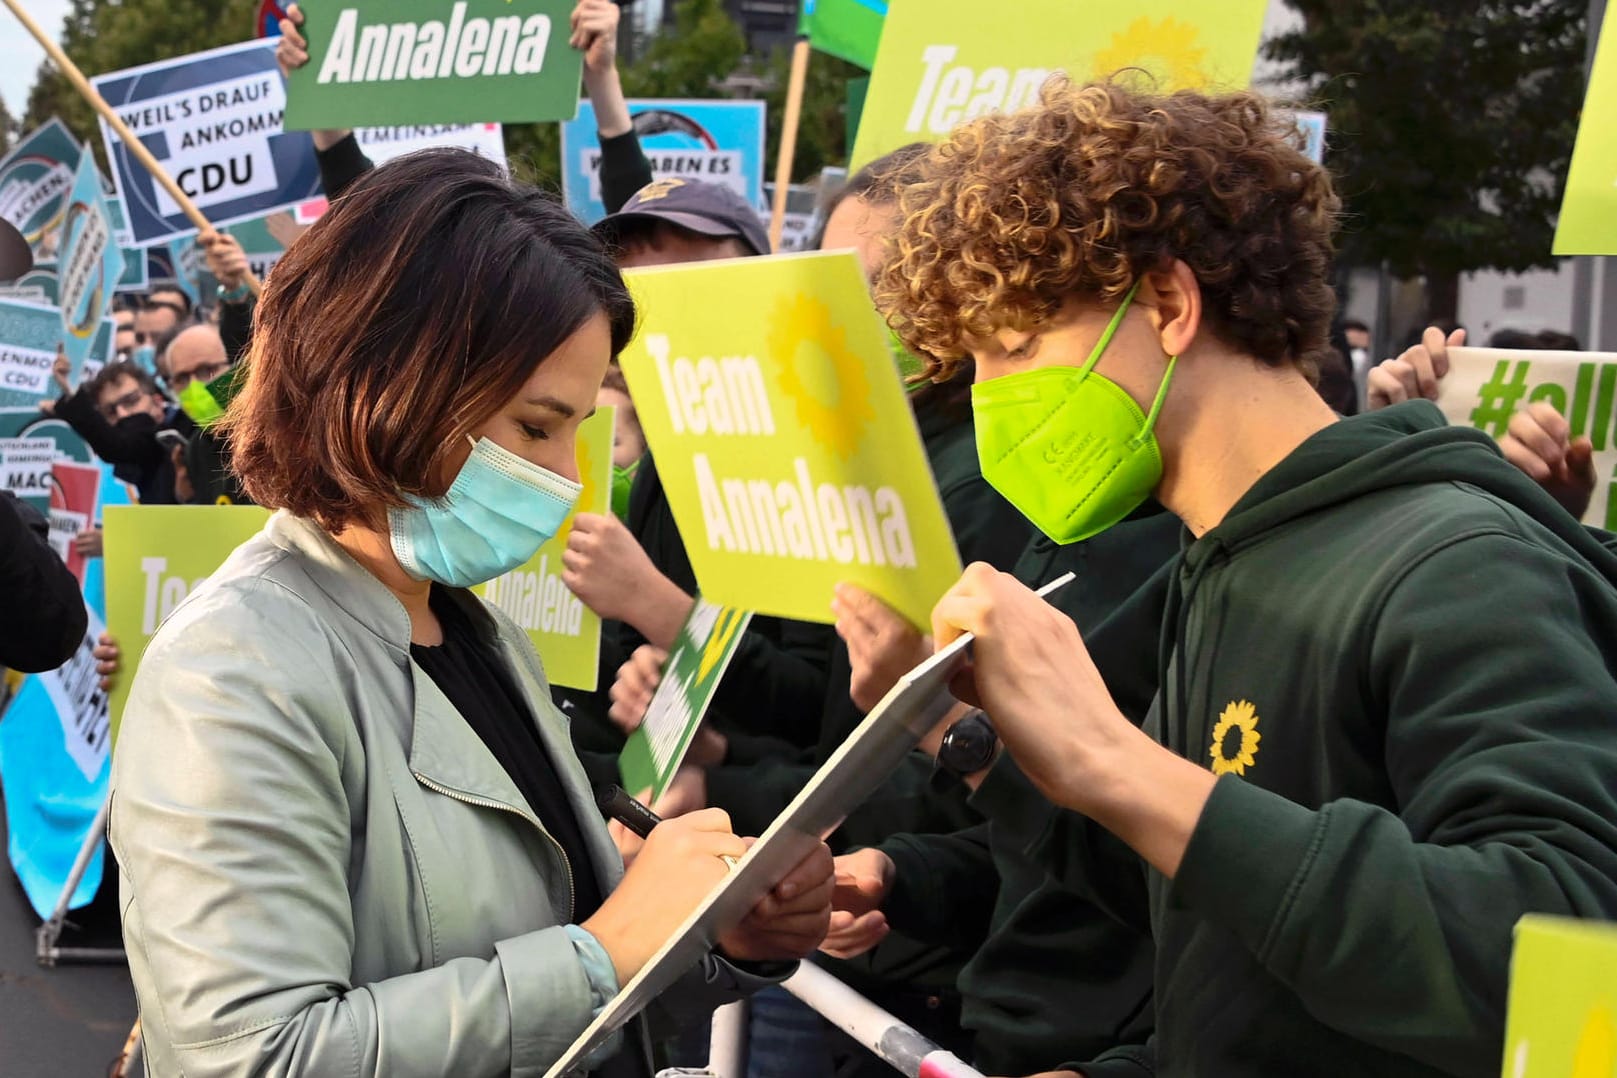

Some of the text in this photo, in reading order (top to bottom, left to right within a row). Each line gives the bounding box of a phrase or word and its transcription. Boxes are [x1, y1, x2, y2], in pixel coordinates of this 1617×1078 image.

[317, 1, 551, 84] Annalena
[122, 80, 271, 130] WEIL'S DRAUF
[176, 153, 253, 198] CDU
[708, 156, 731, 174] ES
[5, 371, 40, 387] CDU
[645, 333, 776, 436] Team
[693, 452, 917, 571] Annalena
